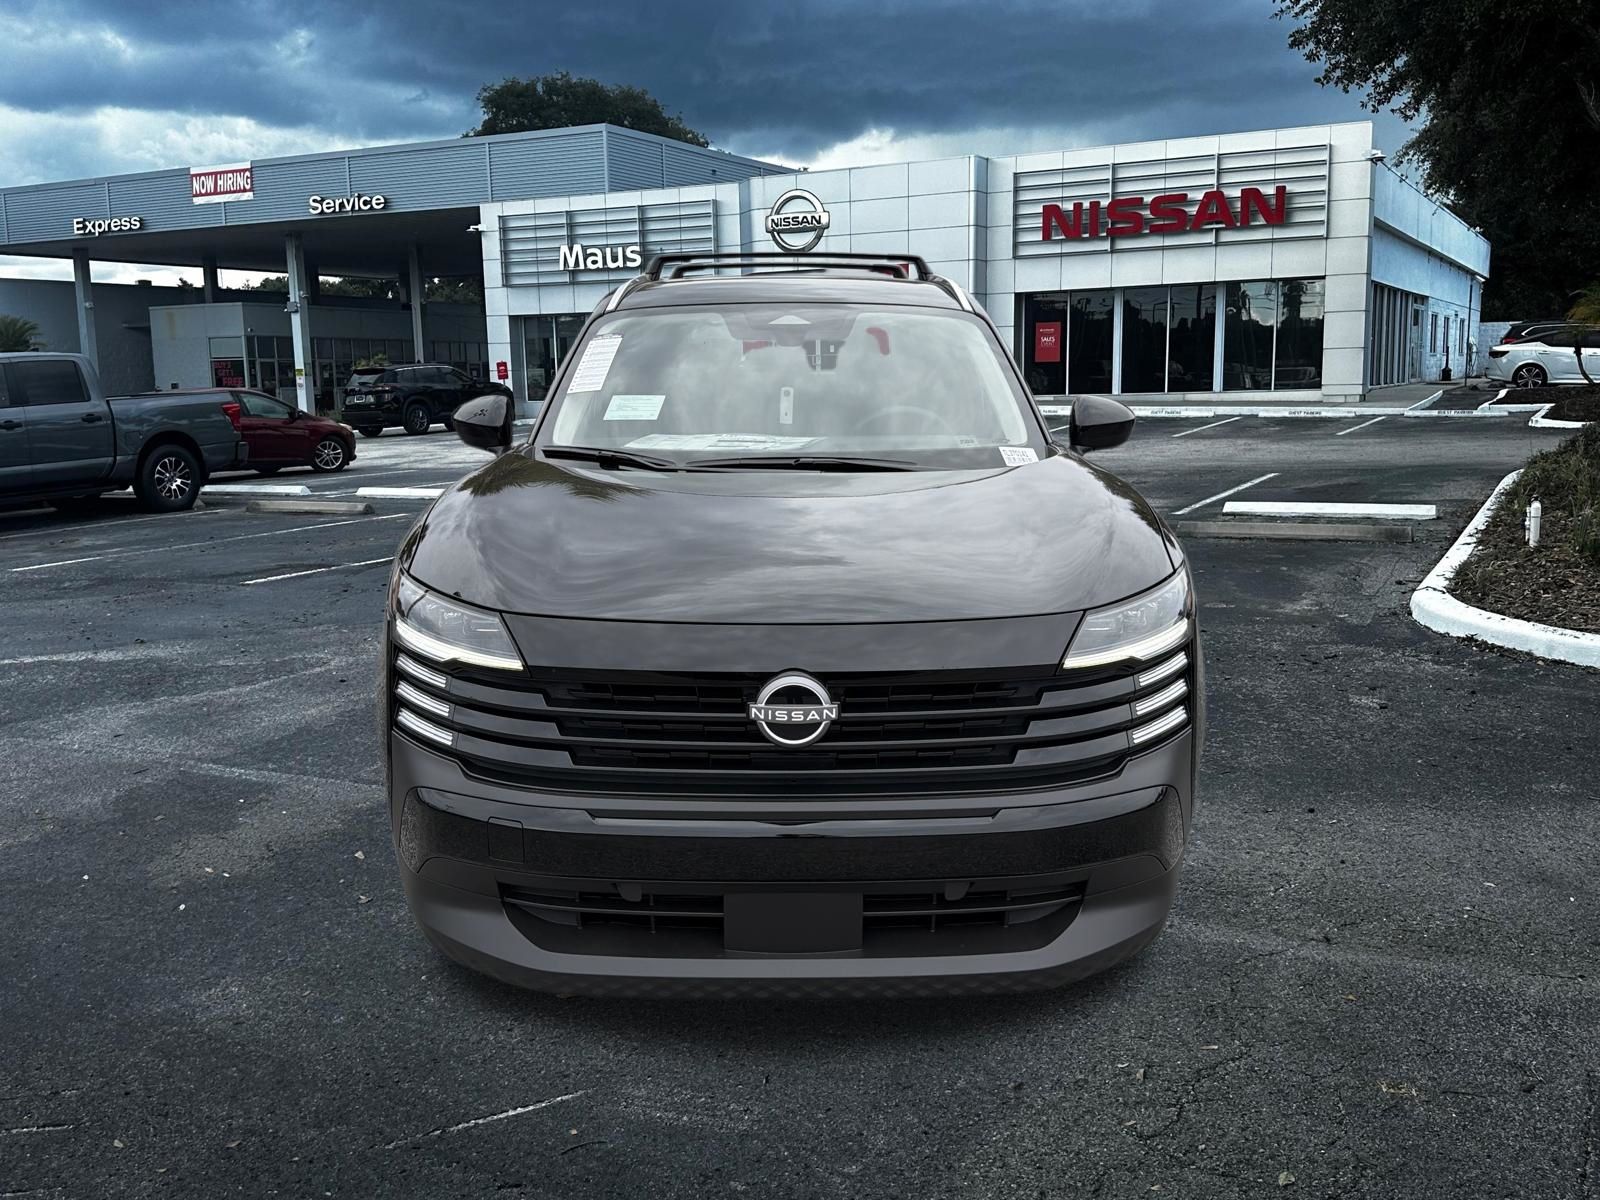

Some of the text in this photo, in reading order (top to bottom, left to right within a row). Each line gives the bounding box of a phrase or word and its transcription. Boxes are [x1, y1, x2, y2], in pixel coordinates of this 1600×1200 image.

[192, 171, 251, 195] NOW HIRING
[309, 193, 385, 215] Service
[1042, 185, 1287, 241] NISSAN
[73, 216, 141, 237] Express
[770, 214, 822, 228] NISSAN
[559, 243, 642, 271] Maus
[223, 376, 244, 386] FREE
[751, 707, 836, 721] NISSAN
